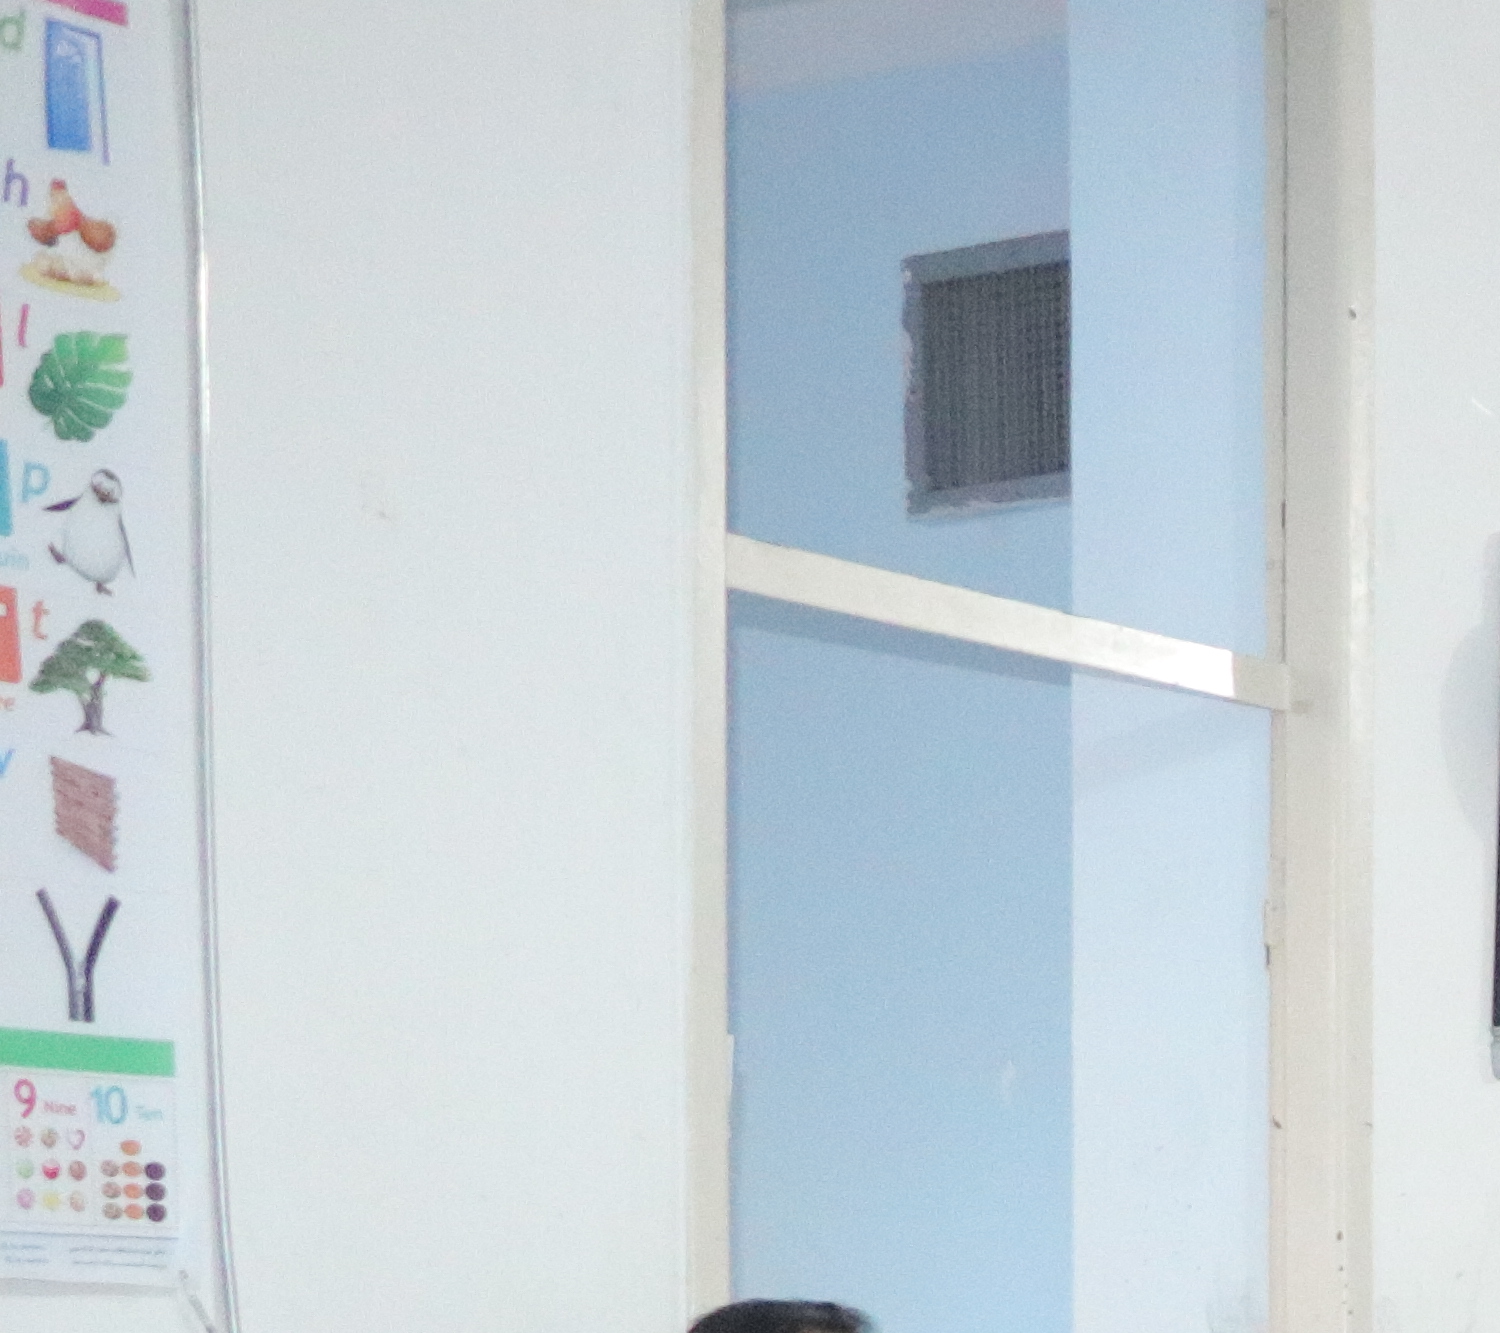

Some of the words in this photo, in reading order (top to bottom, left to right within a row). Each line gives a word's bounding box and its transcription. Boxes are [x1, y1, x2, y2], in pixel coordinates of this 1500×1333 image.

[4, 158, 28, 208] h
[22, 461, 50, 504] p
[31, 600, 50, 641] t
[14, 1078, 37, 1119] 9
[91, 1085, 128, 1125] 10
